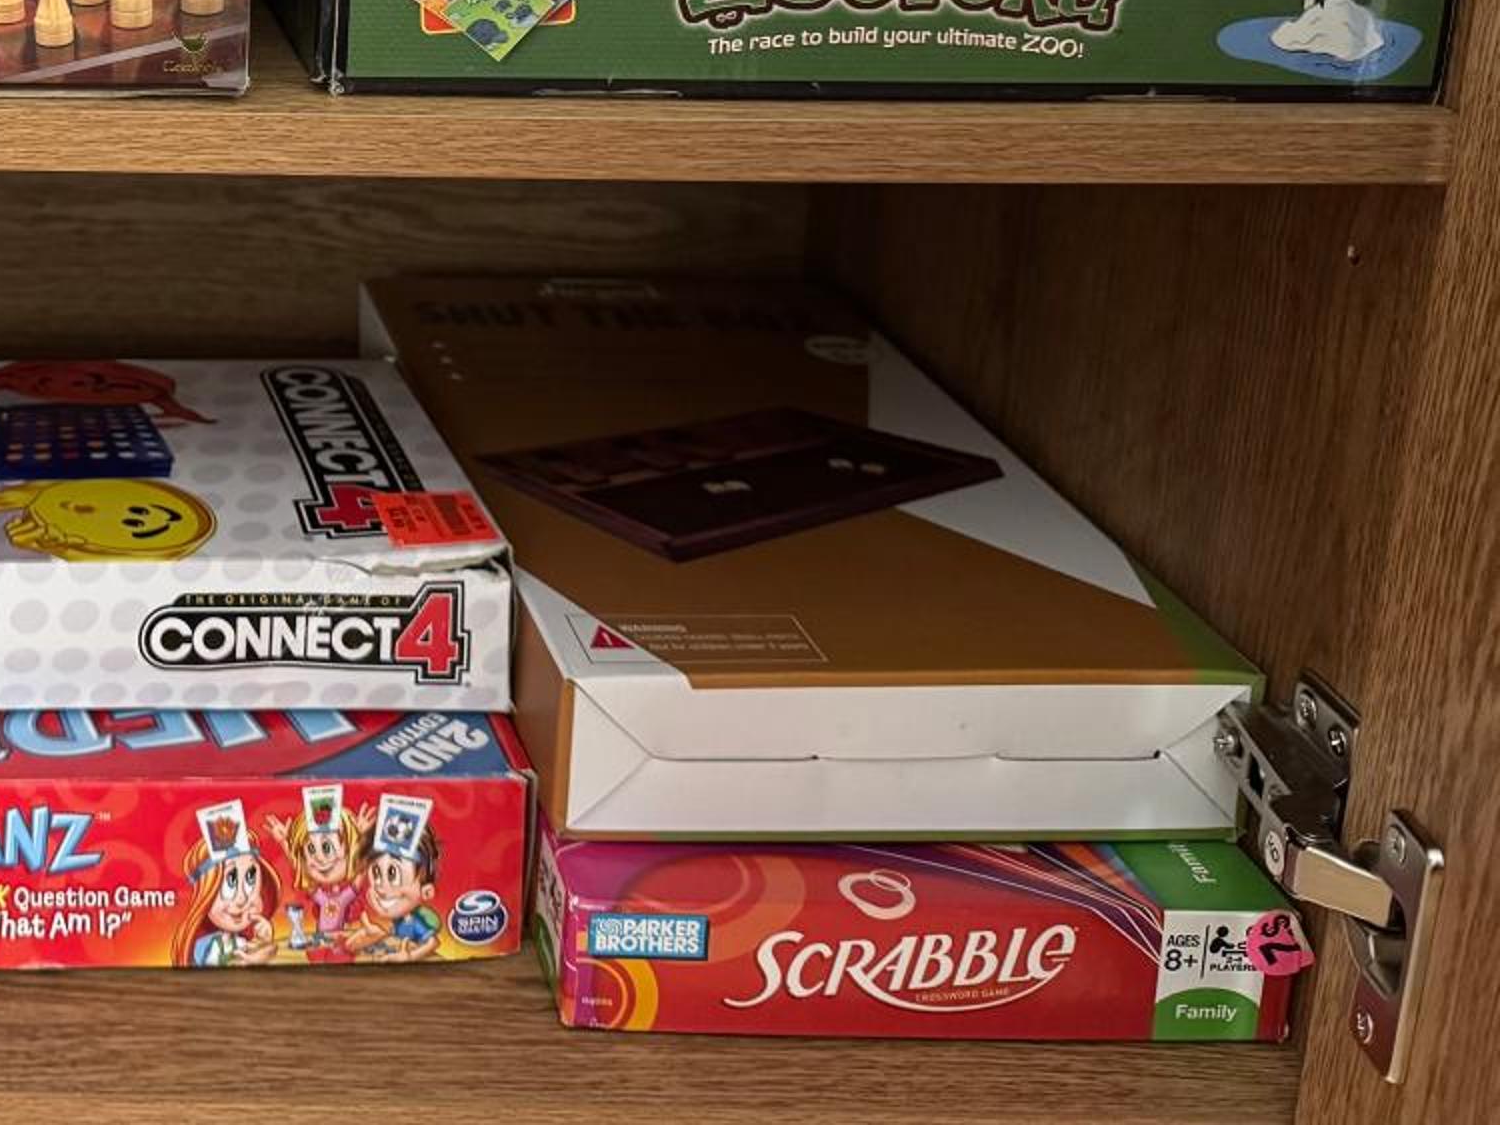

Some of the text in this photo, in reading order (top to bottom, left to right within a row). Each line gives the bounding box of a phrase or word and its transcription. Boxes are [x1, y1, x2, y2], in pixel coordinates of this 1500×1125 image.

[708, 25, 1085, 59] The race to build your ultimate ZOO!
[275, 368, 391, 487] CONNECT
[184, 594, 215, 606] THE
[149, 592, 460, 675] CONNECT 4
[376, 711, 447, 757] EDITION
[396, 718, 489, 773] 2ND
[13, 885, 109, 913] Question
[113, 885, 176, 908] Game
[49, 911, 92, 939] Am
[456, 915, 500, 928] SPIN
[623, 919, 700, 937] PARKER
[596, 936, 699, 953] BROTHERS
[1166, 935, 1200, 948] AGES
[1164, 950, 1198, 971] 8+
[1175, 1004, 1237, 1022] Family
